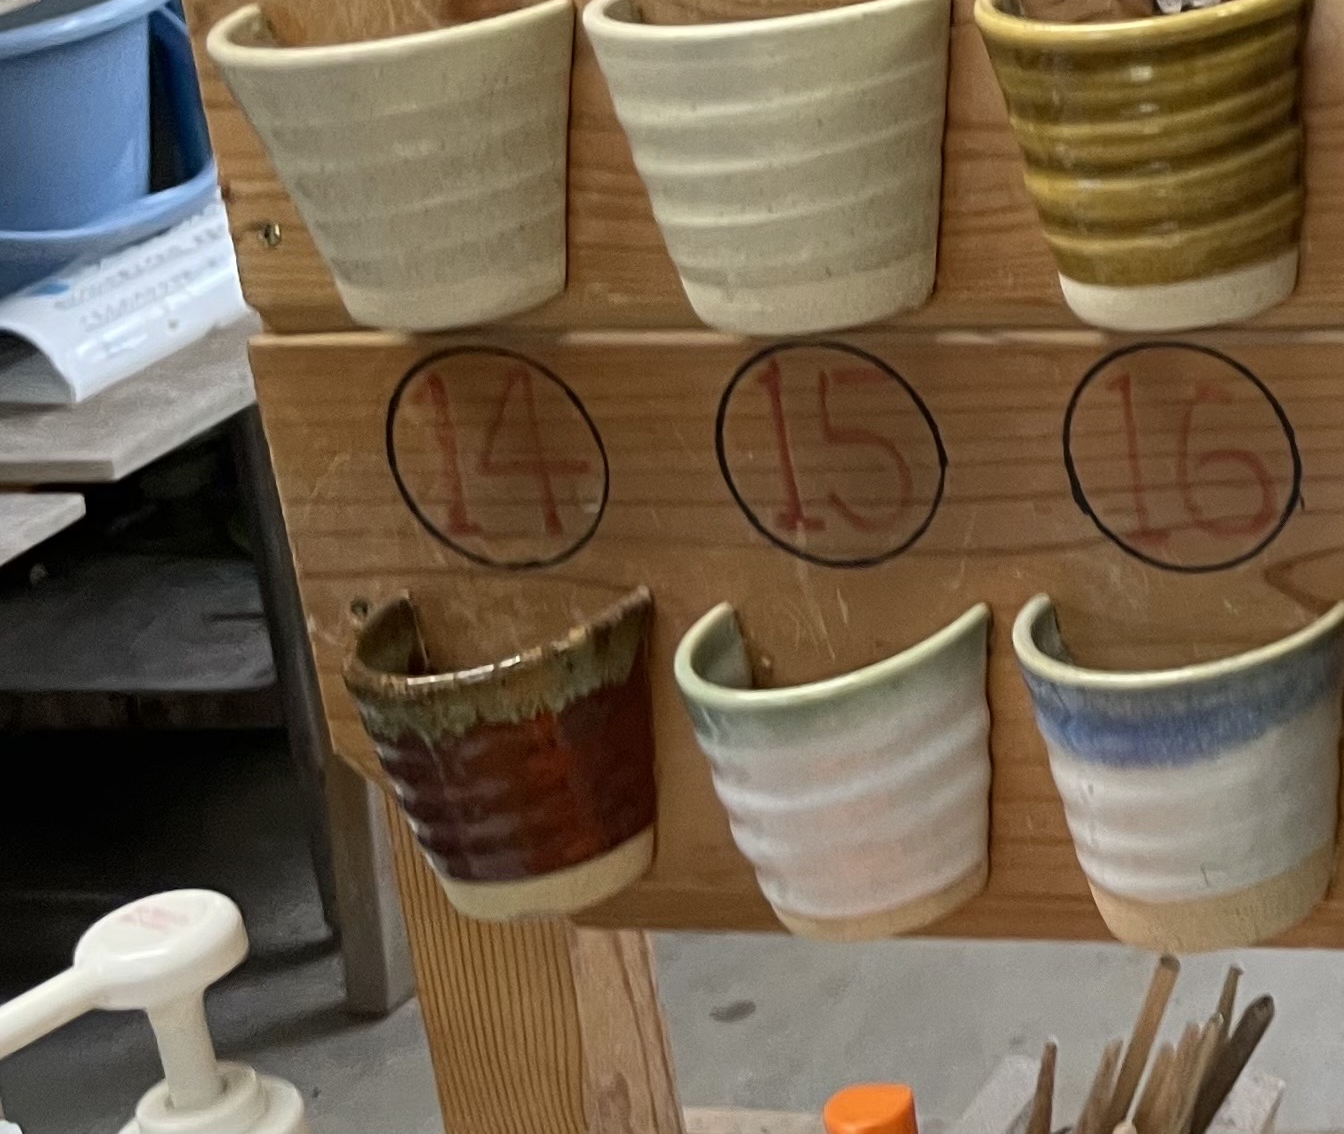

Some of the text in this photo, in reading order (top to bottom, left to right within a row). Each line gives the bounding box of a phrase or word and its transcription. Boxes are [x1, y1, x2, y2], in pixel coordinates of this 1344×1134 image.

[412, 364, 591, 536] 14
[760, 359, 914, 533] 15
[1106, 371, 1278, 547] 16
